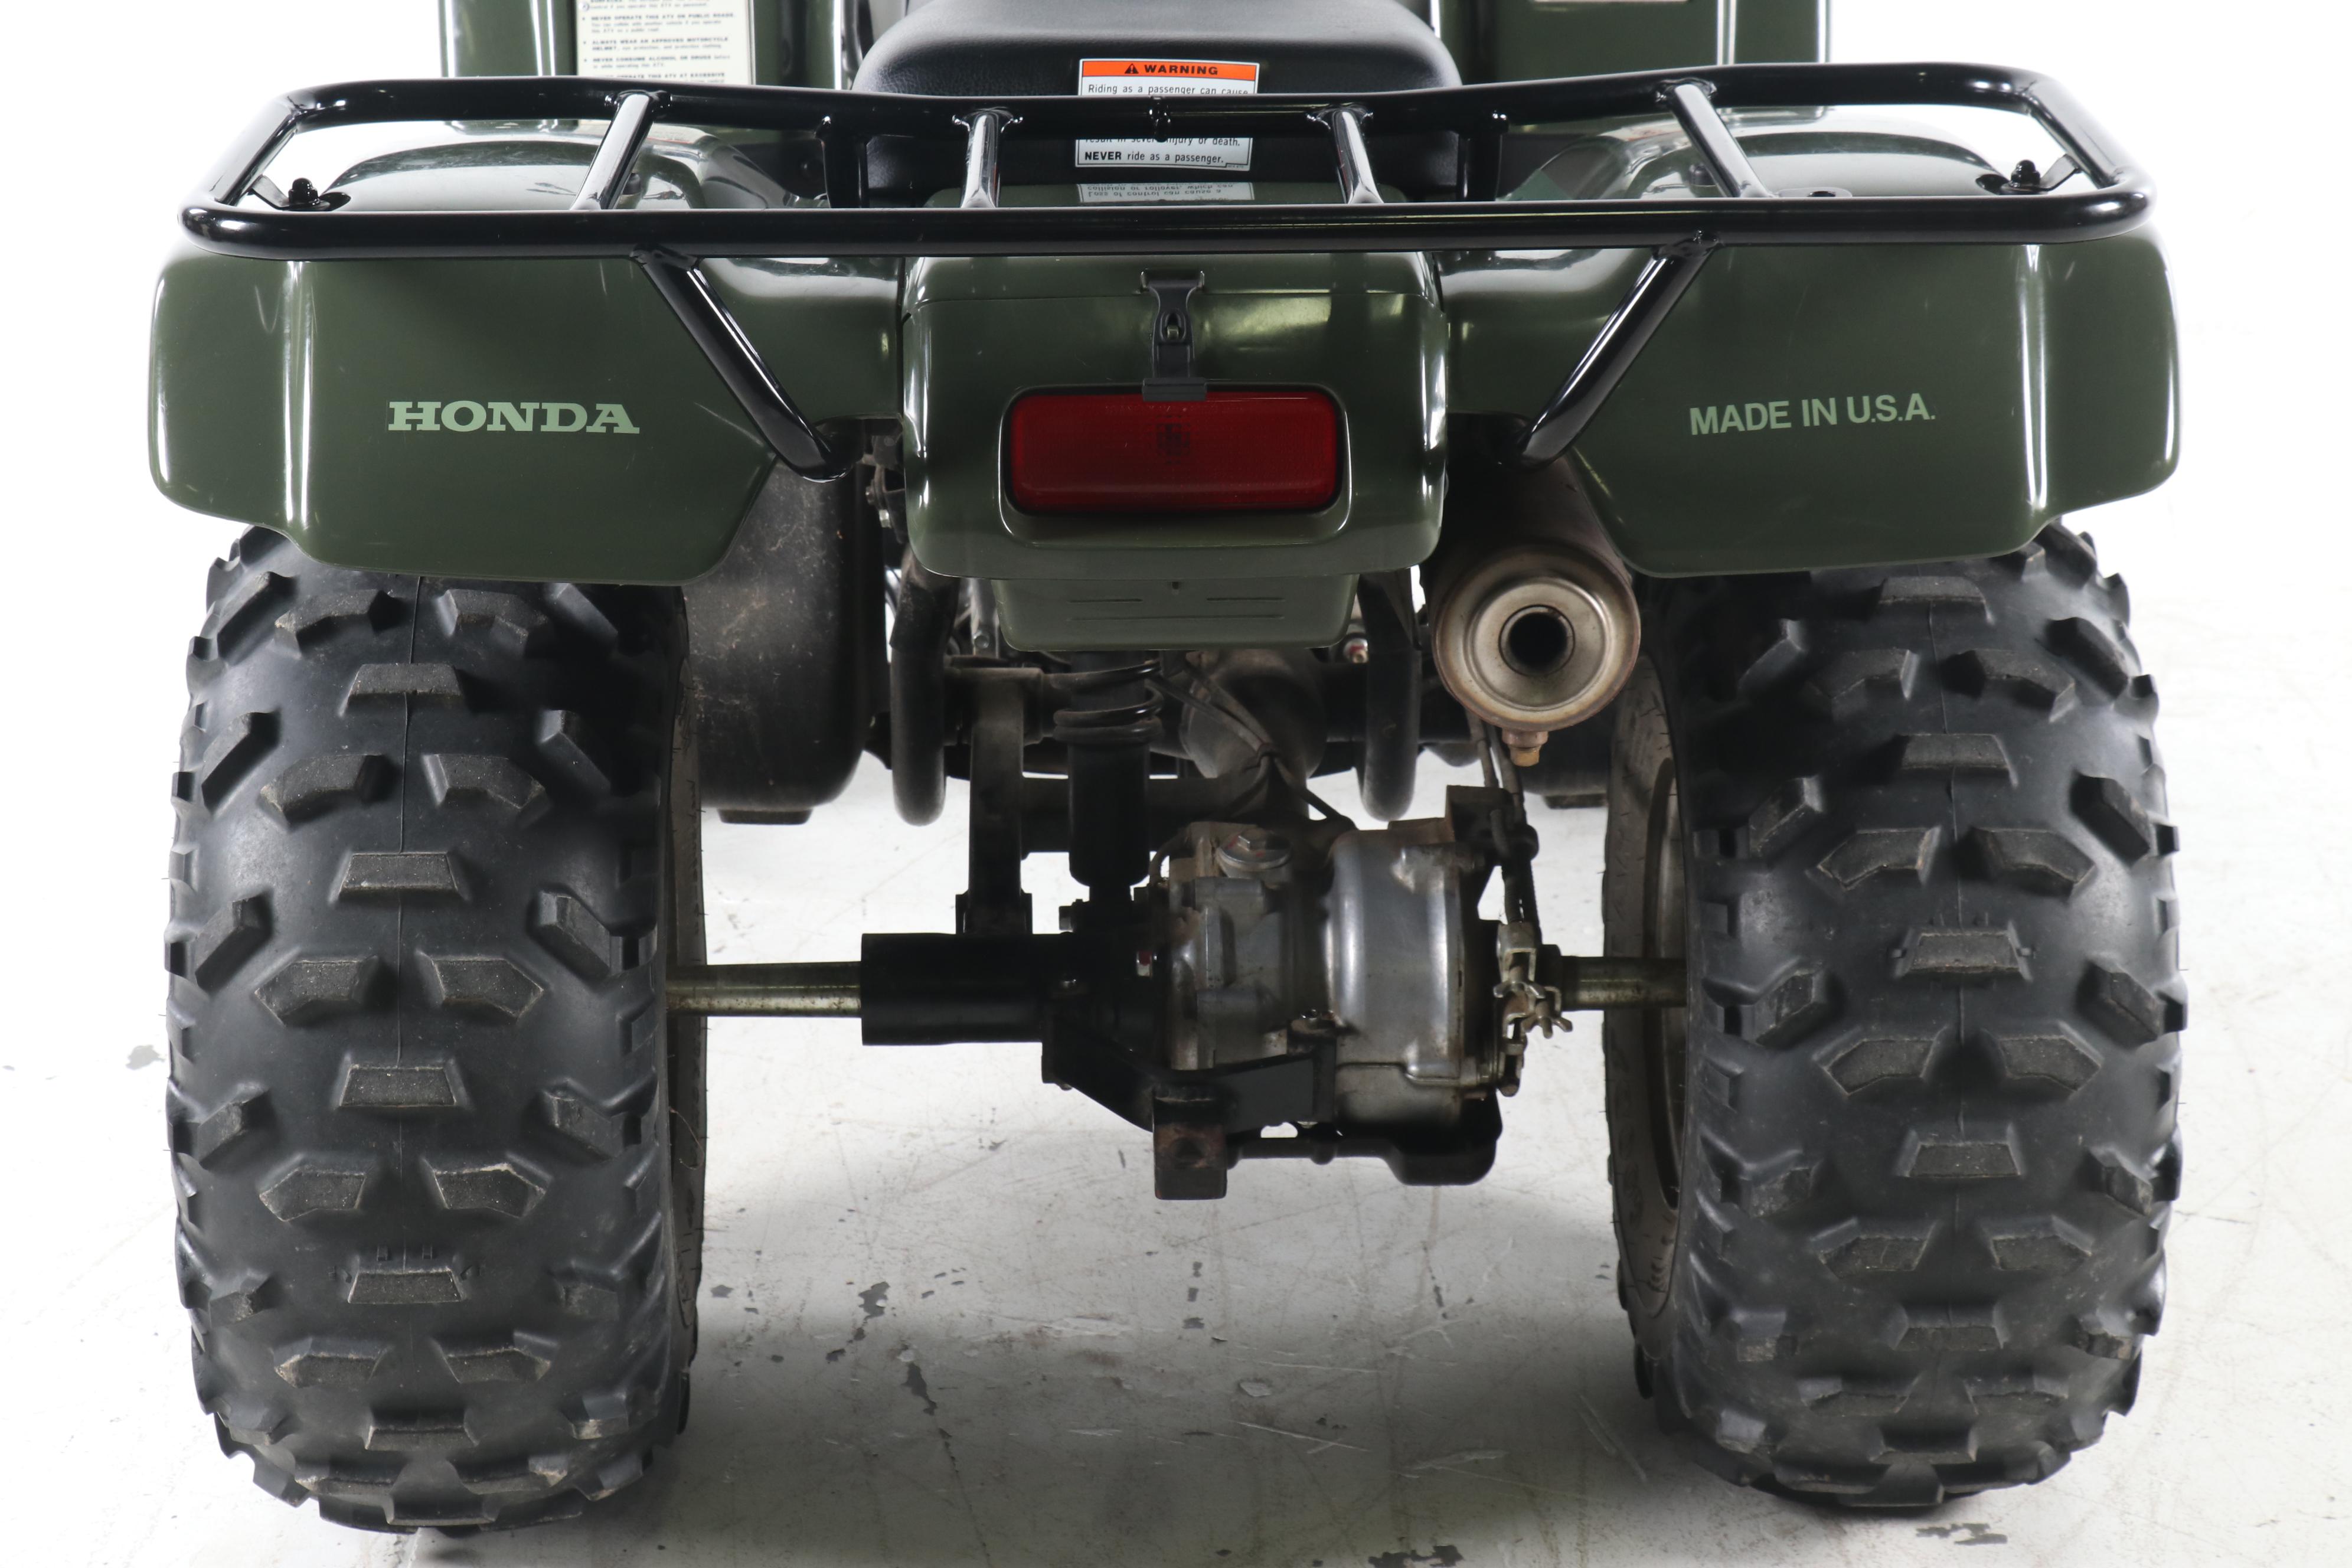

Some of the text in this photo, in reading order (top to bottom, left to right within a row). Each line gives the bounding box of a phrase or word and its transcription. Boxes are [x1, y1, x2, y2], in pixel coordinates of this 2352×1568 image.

[1144, 64, 1219, 75] WARNING
[1088, 84, 1118, 94] Riding
[1148, 86, 1195, 94] passenger
[1213, 138, 1240, 146] death.
[1084, 151, 1122, 160] NEVER
[1127, 152, 1145, 161] ride
[1175, 153, 1224, 165] passenger.
[388, 400, 640, 434] HONDA
[1689, 393, 1936, 435] MADE IN U.S.A.
